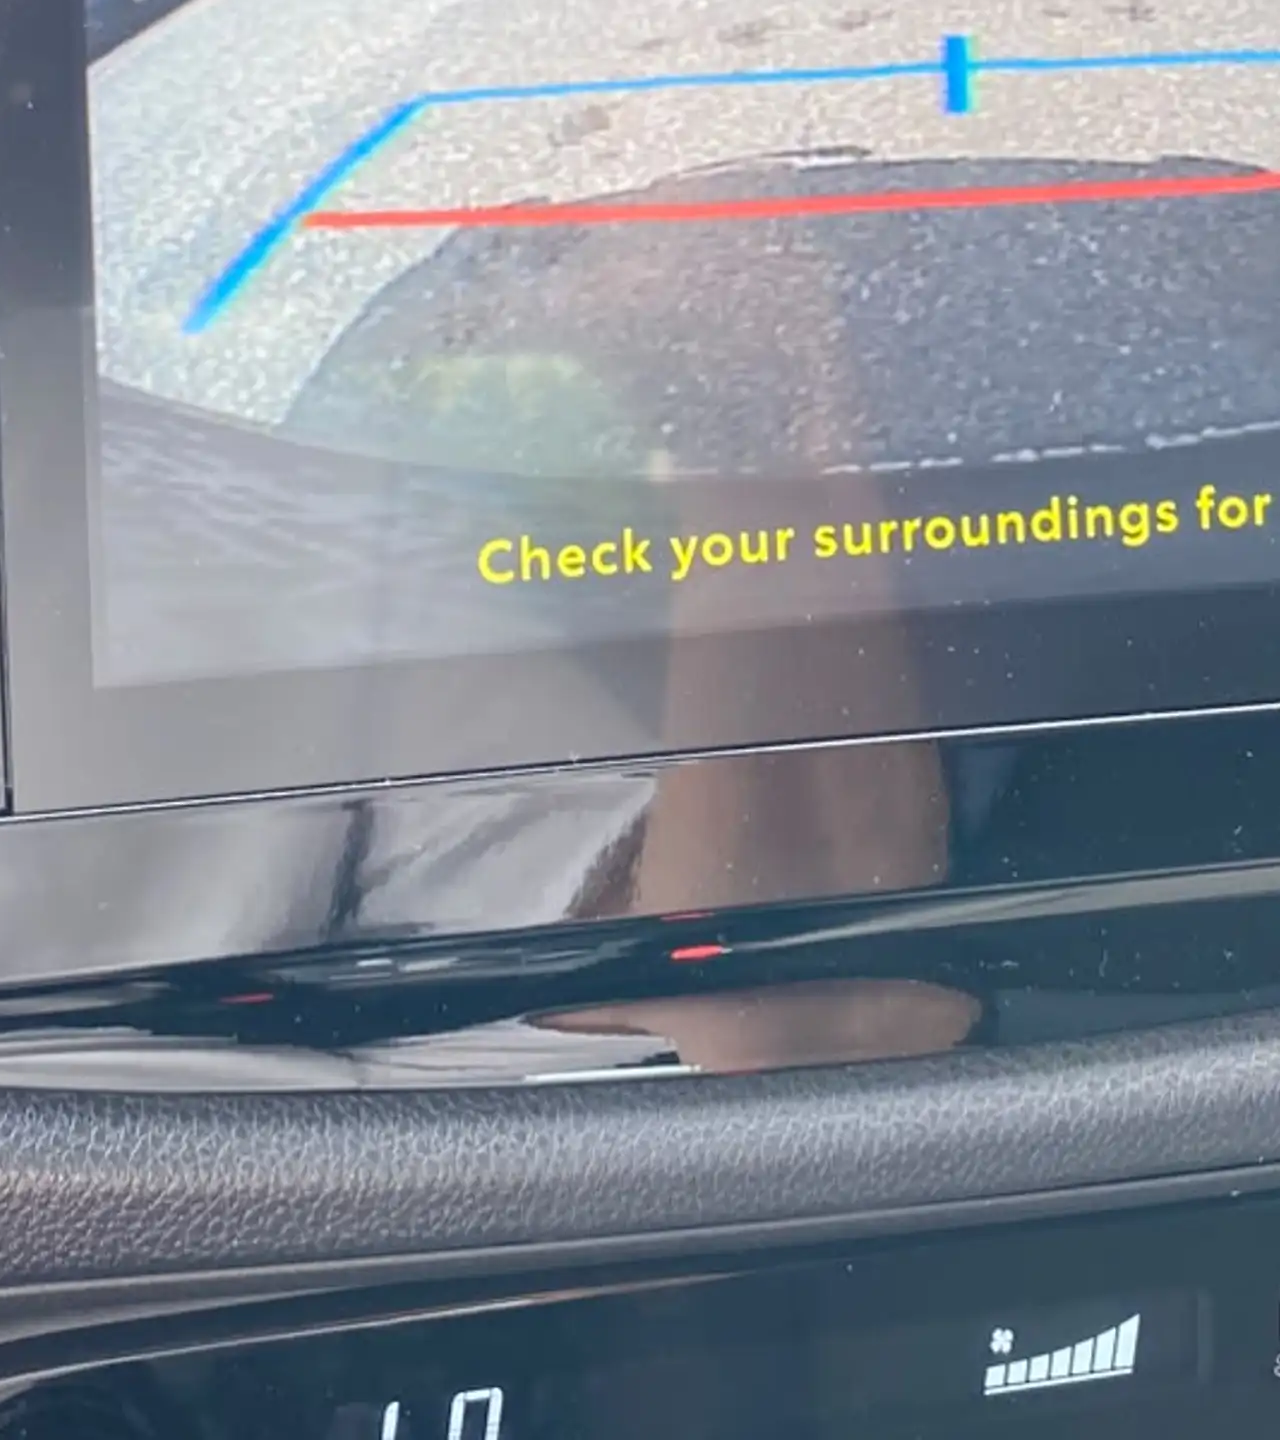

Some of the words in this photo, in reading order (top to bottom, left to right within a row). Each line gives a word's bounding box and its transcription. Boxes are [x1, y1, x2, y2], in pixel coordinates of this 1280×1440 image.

[477, 529, 651, 583] Check
[670, 527, 794, 582] your
[812, 495, 1180, 559] surroundings
[1195, 484, 1270, 529] for
